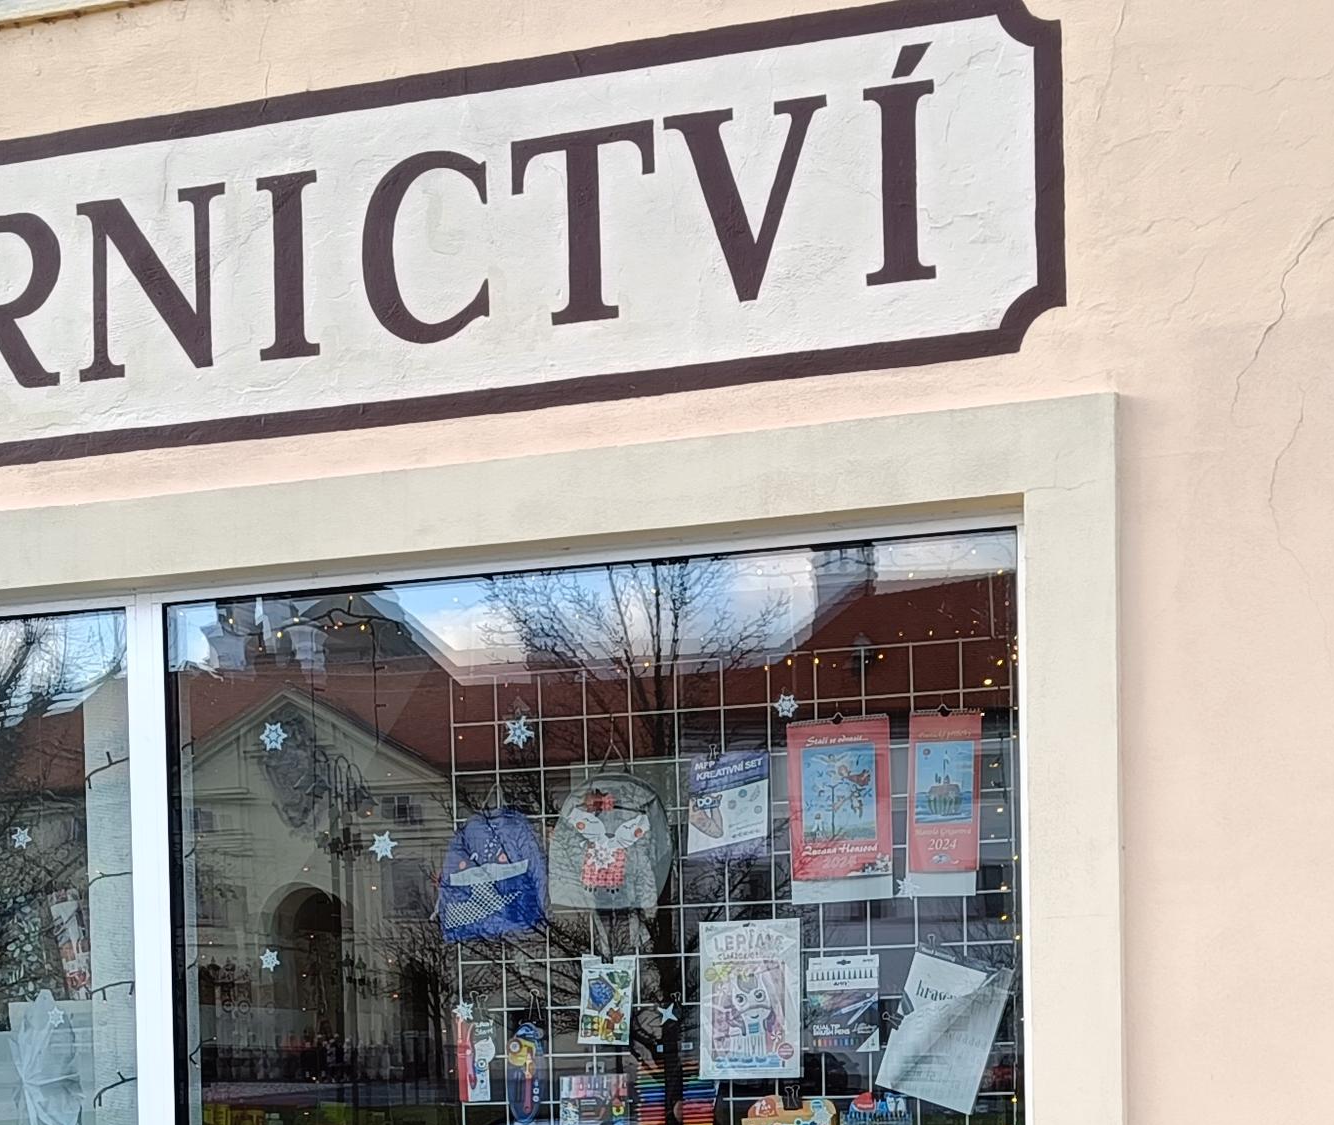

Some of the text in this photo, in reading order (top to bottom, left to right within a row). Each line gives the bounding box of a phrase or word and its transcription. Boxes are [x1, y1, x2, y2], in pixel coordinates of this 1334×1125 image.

[695, 757, 764, 781] KREATIVNÍ SET
[927, 838, 957, 850] 2024
